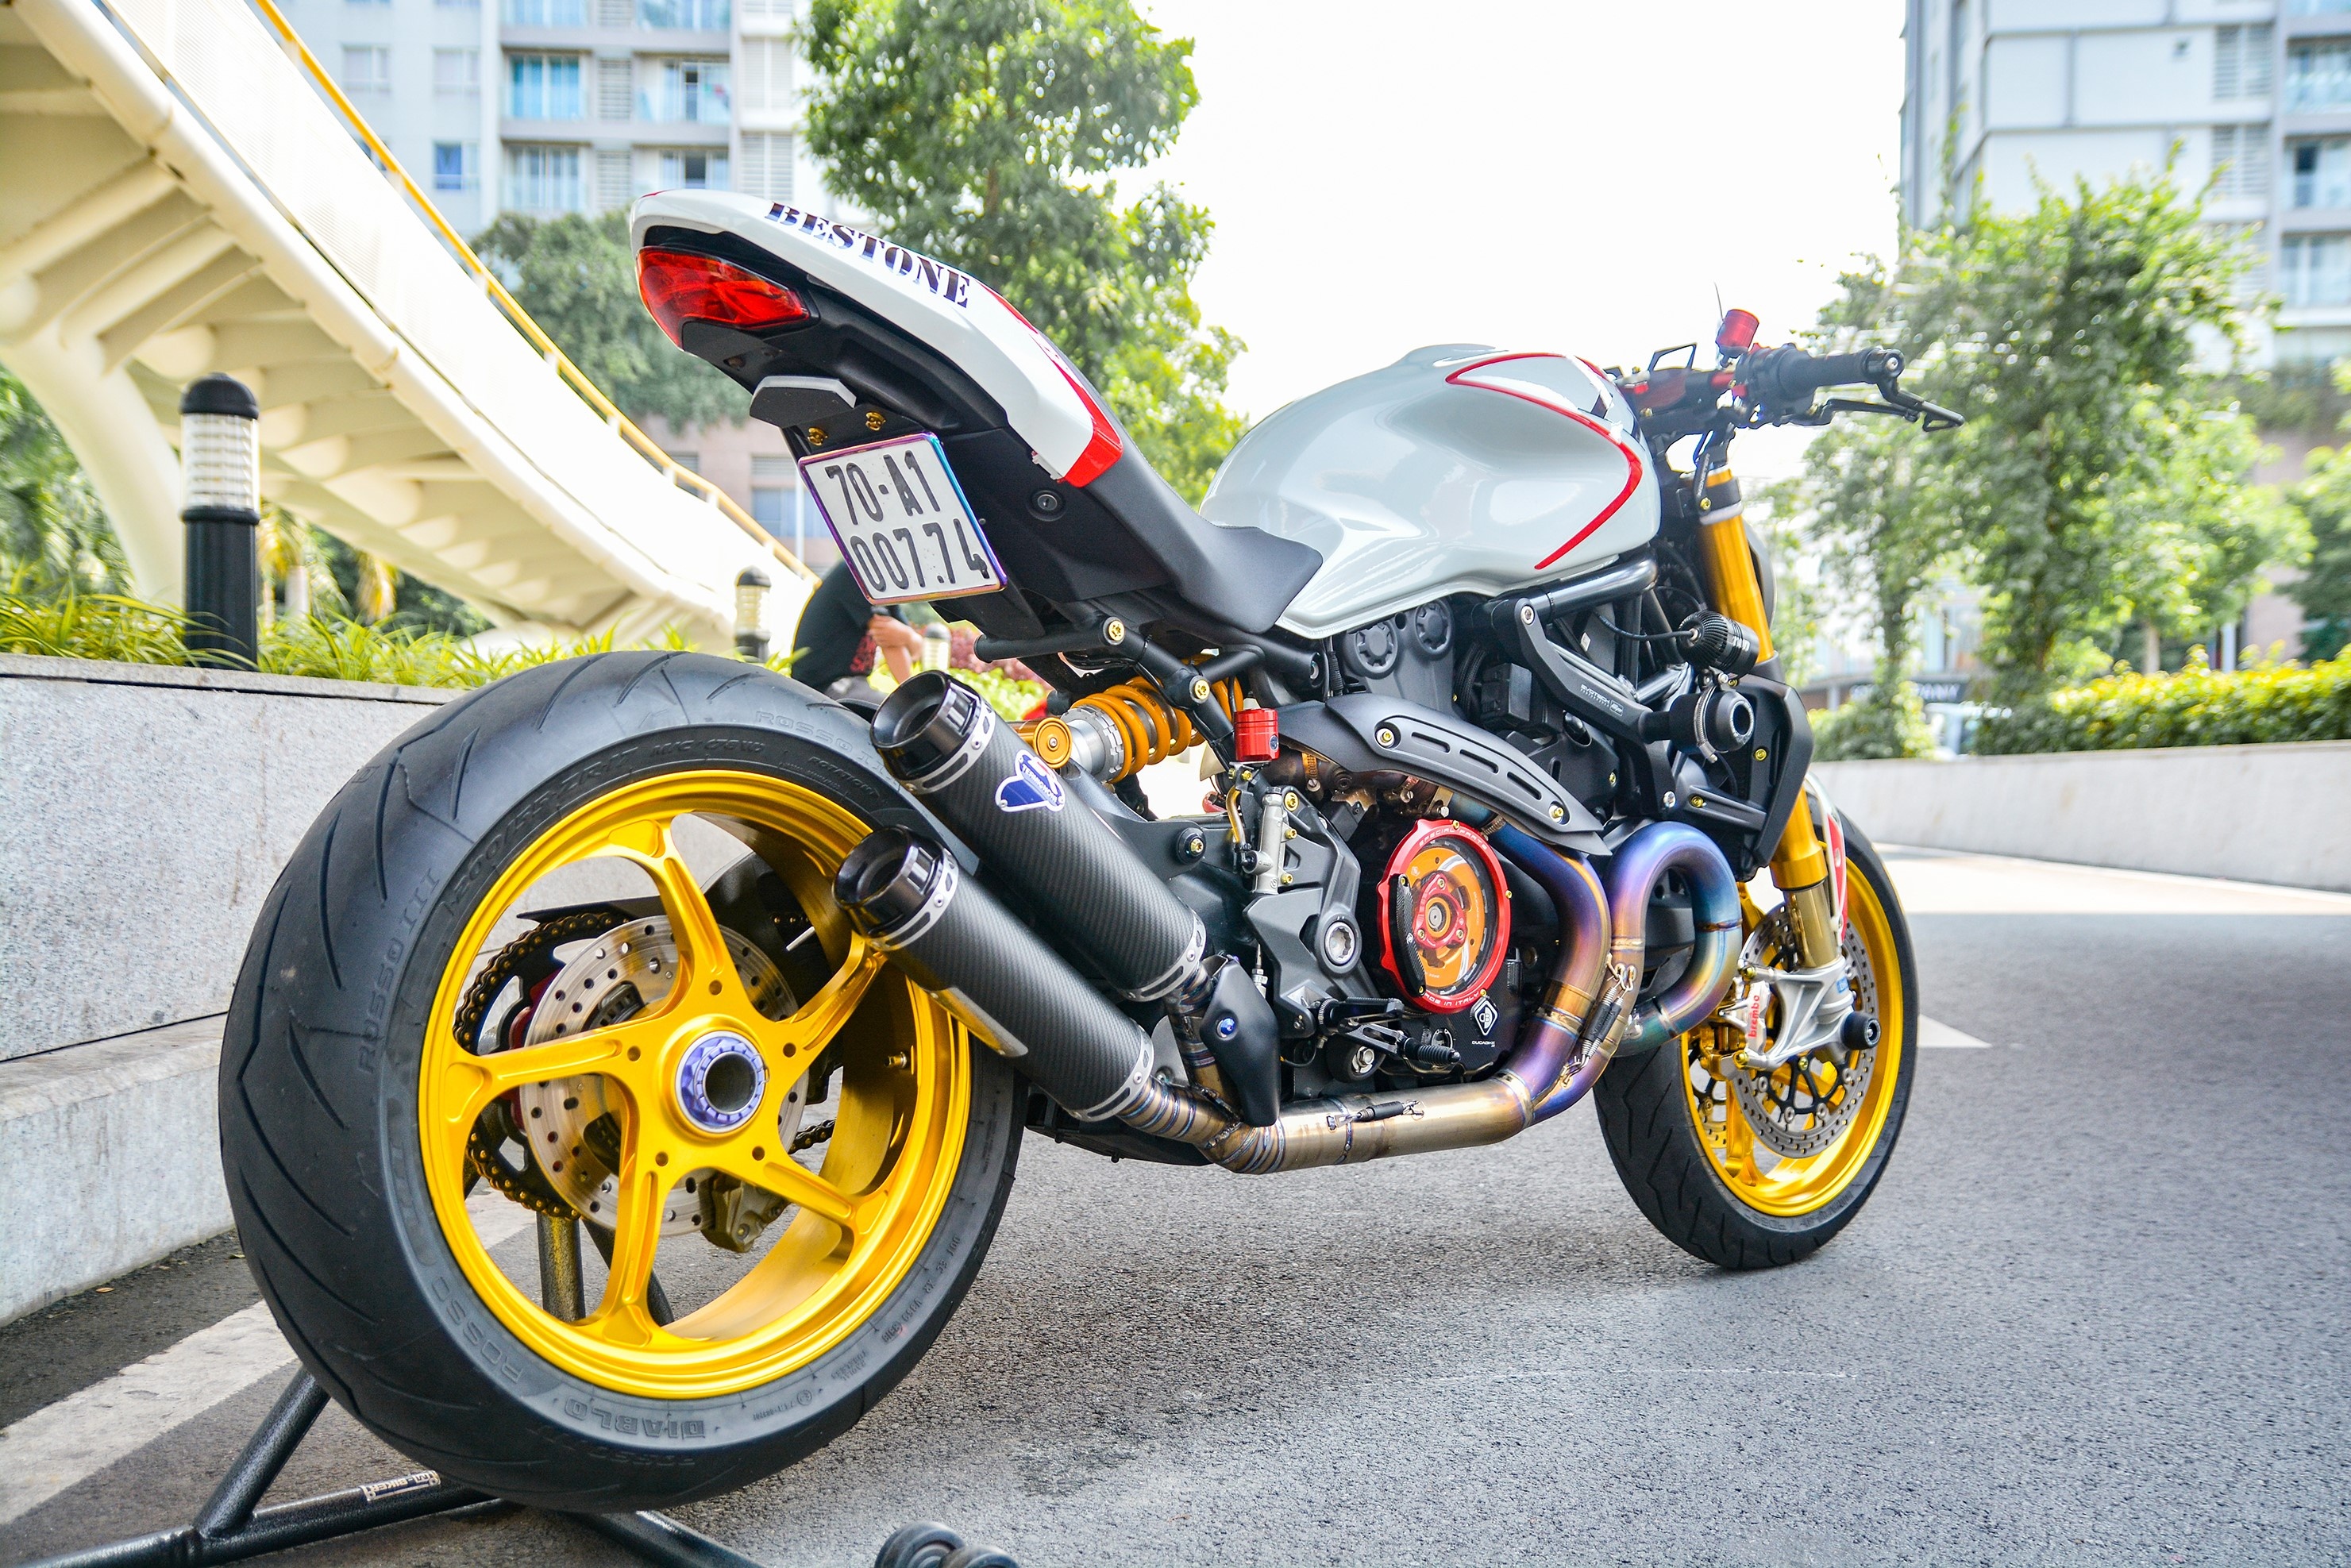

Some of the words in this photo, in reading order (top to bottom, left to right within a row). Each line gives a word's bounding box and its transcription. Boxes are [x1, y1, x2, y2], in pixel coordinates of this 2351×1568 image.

[765, 202, 969, 308] BESTONE
[850, 518, 989, 592] 007.74
[755, 711, 854, 753] ROSSO
[1022, 763, 1057, 803] TERMIGNONI
[1419, 828, 1455, 847] SPECIAL
[1457, 828, 1488, 850] PARTS
[1455, 991, 1479, 1006] ITALY
[1748, 995, 1760, 1039] brembo
[433, 1276, 522, 1384] ROSSO
[565, 1397, 706, 1440] DIABLO
